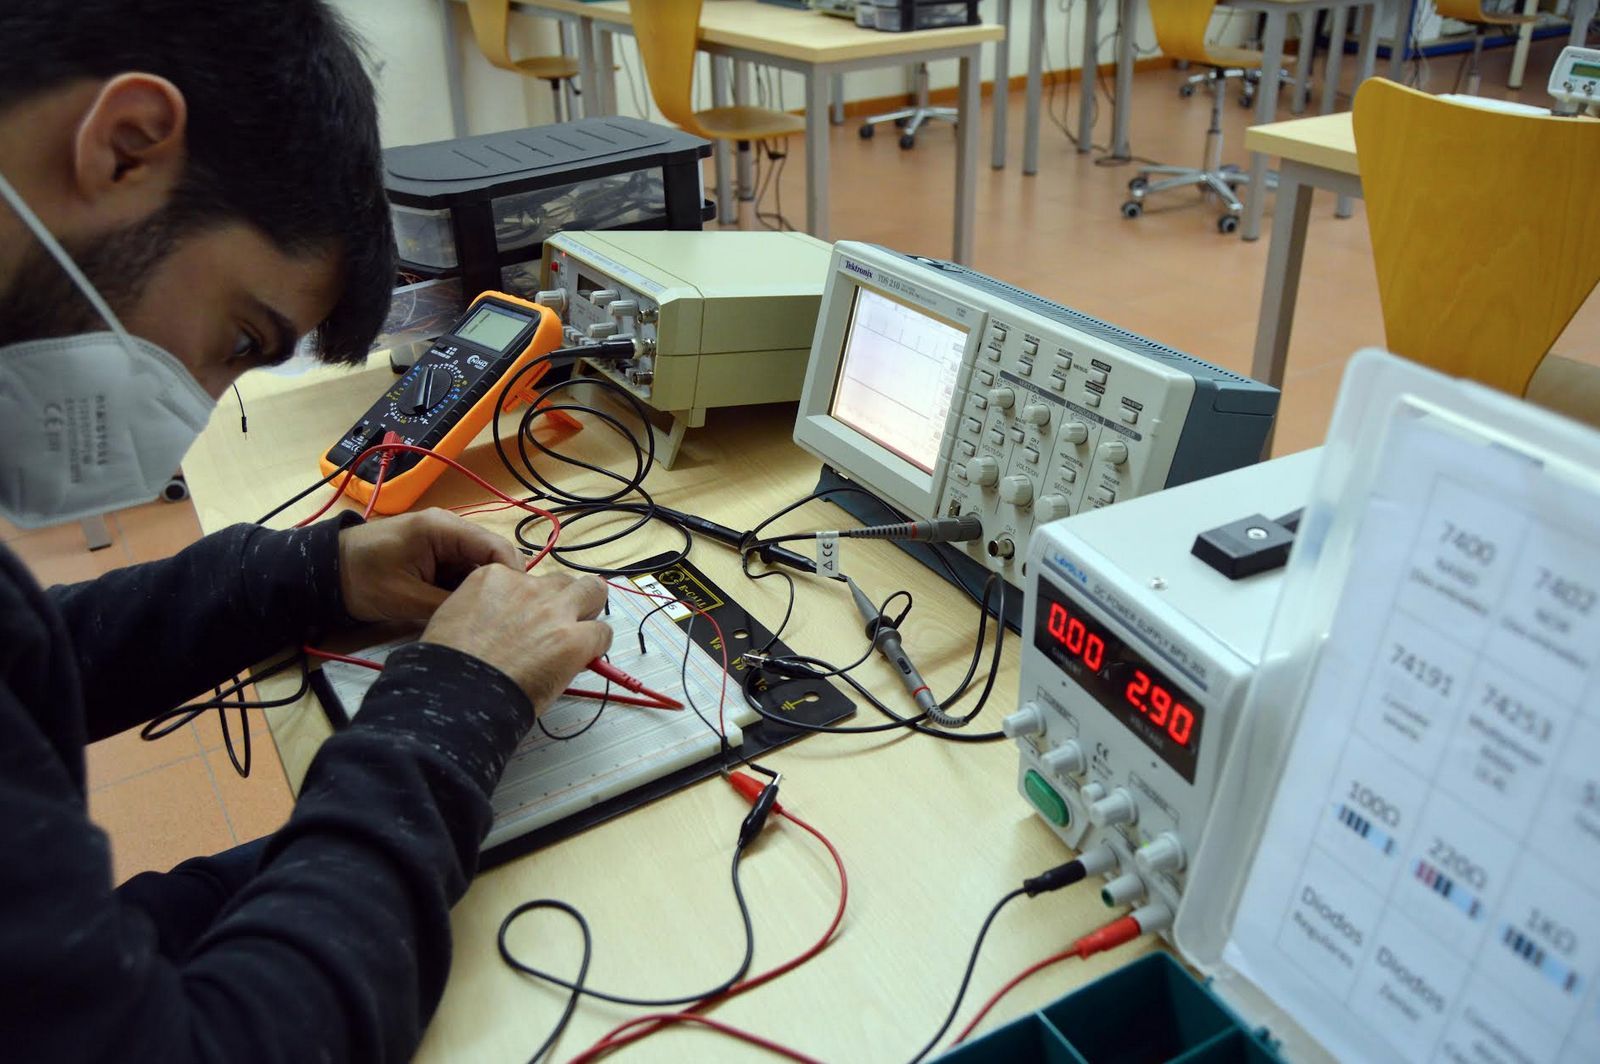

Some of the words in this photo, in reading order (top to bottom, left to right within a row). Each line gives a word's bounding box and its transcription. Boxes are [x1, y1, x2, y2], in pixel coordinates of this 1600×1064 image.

[845, 260, 874, 280] Tektronix
[822, 543, 833, 557] CE
[1439, 520, 1497, 567] 7400
[1048, 600, 1105, 671] 0.00
[1391, 643, 1453, 697] 74191
[1126, 669, 1195, 746] 2.90
[1302, 885, 1363, 946] Diodos
[1376, 946, 1445, 1013] Diodos
